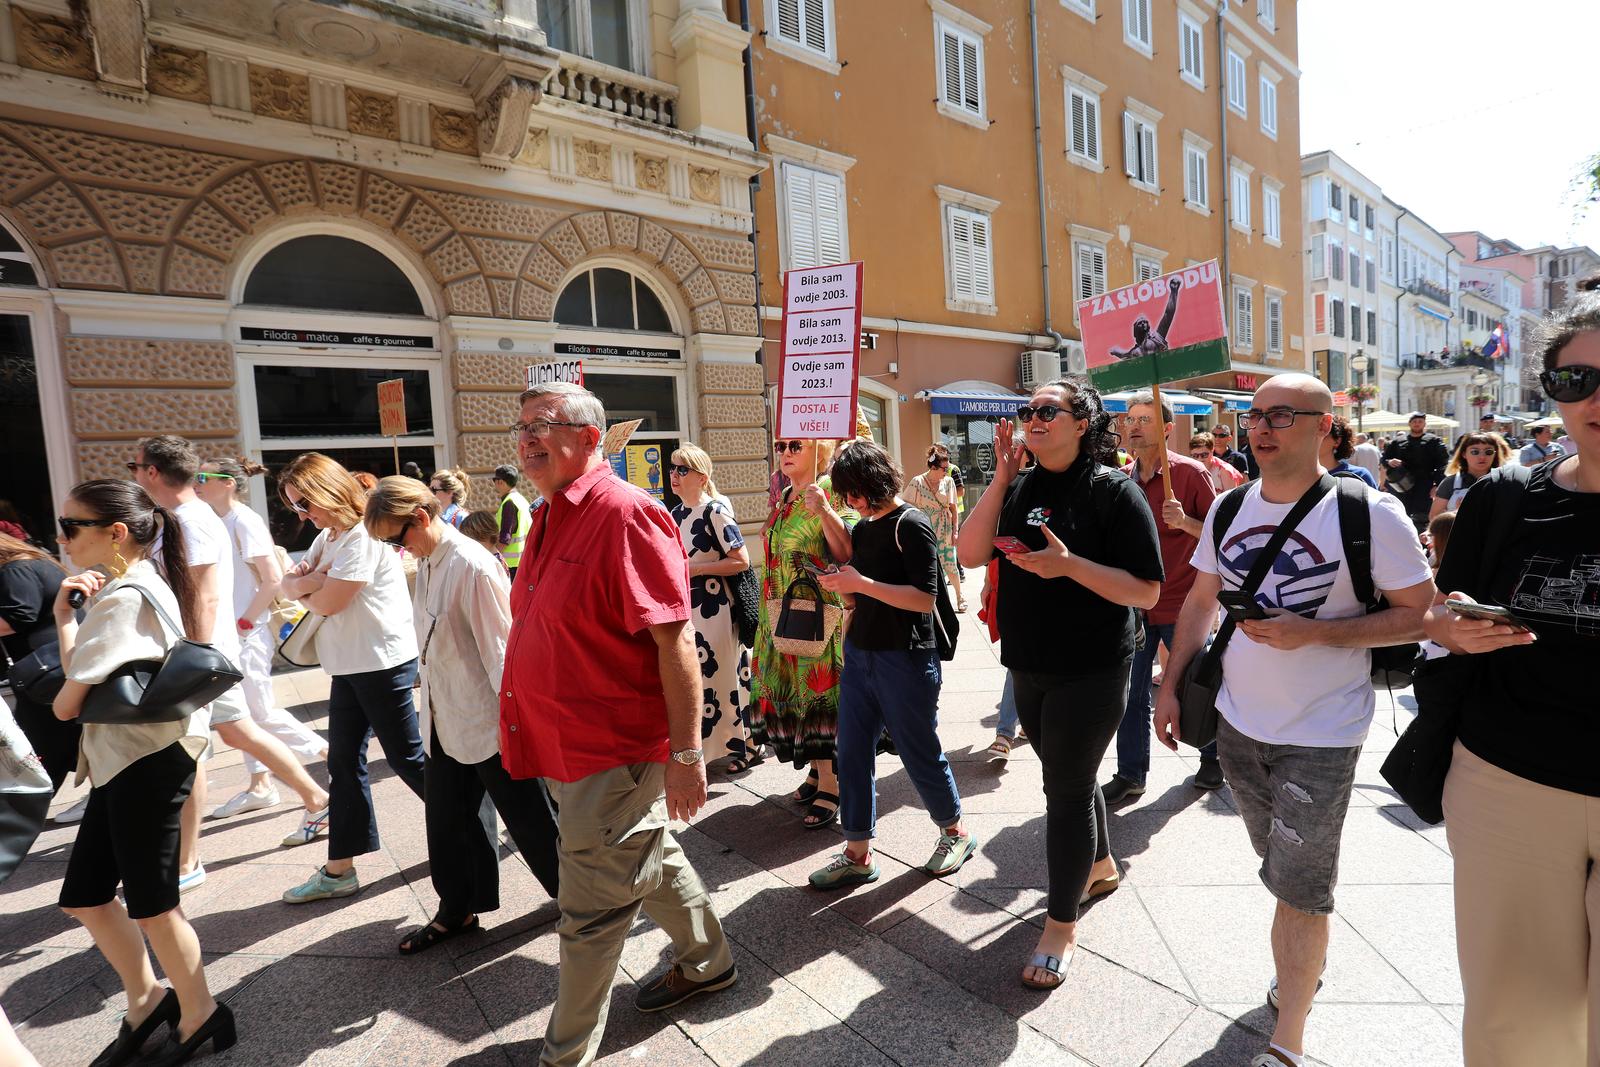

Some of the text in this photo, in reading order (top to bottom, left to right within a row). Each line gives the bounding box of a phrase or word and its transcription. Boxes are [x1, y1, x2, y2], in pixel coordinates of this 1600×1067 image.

[801, 274, 842, 286] Bila sam
[1092, 262, 1216, 316] ZA SLOBODU
[794, 289, 848, 304] ovdje 2003.
[800, 318, 840, 328] Bila sam
[382, 338, 414, 346] gourmet
[792, 334, 846, 346] ovdje 2013.
[554, 361, 581, 384] BOSS
[792, 361, 844, 373] Ovdje sam
[802, 378, 832, 388] 2023.!
[792, 404, 839, 414] DOSTA JE
[960, 402, 988, 412] L'AMORE
[989, 402, 1000, 412] PER
[1001, 403, 1007, 412] IL
[800, 420, 829, 432] VIŠE!!
